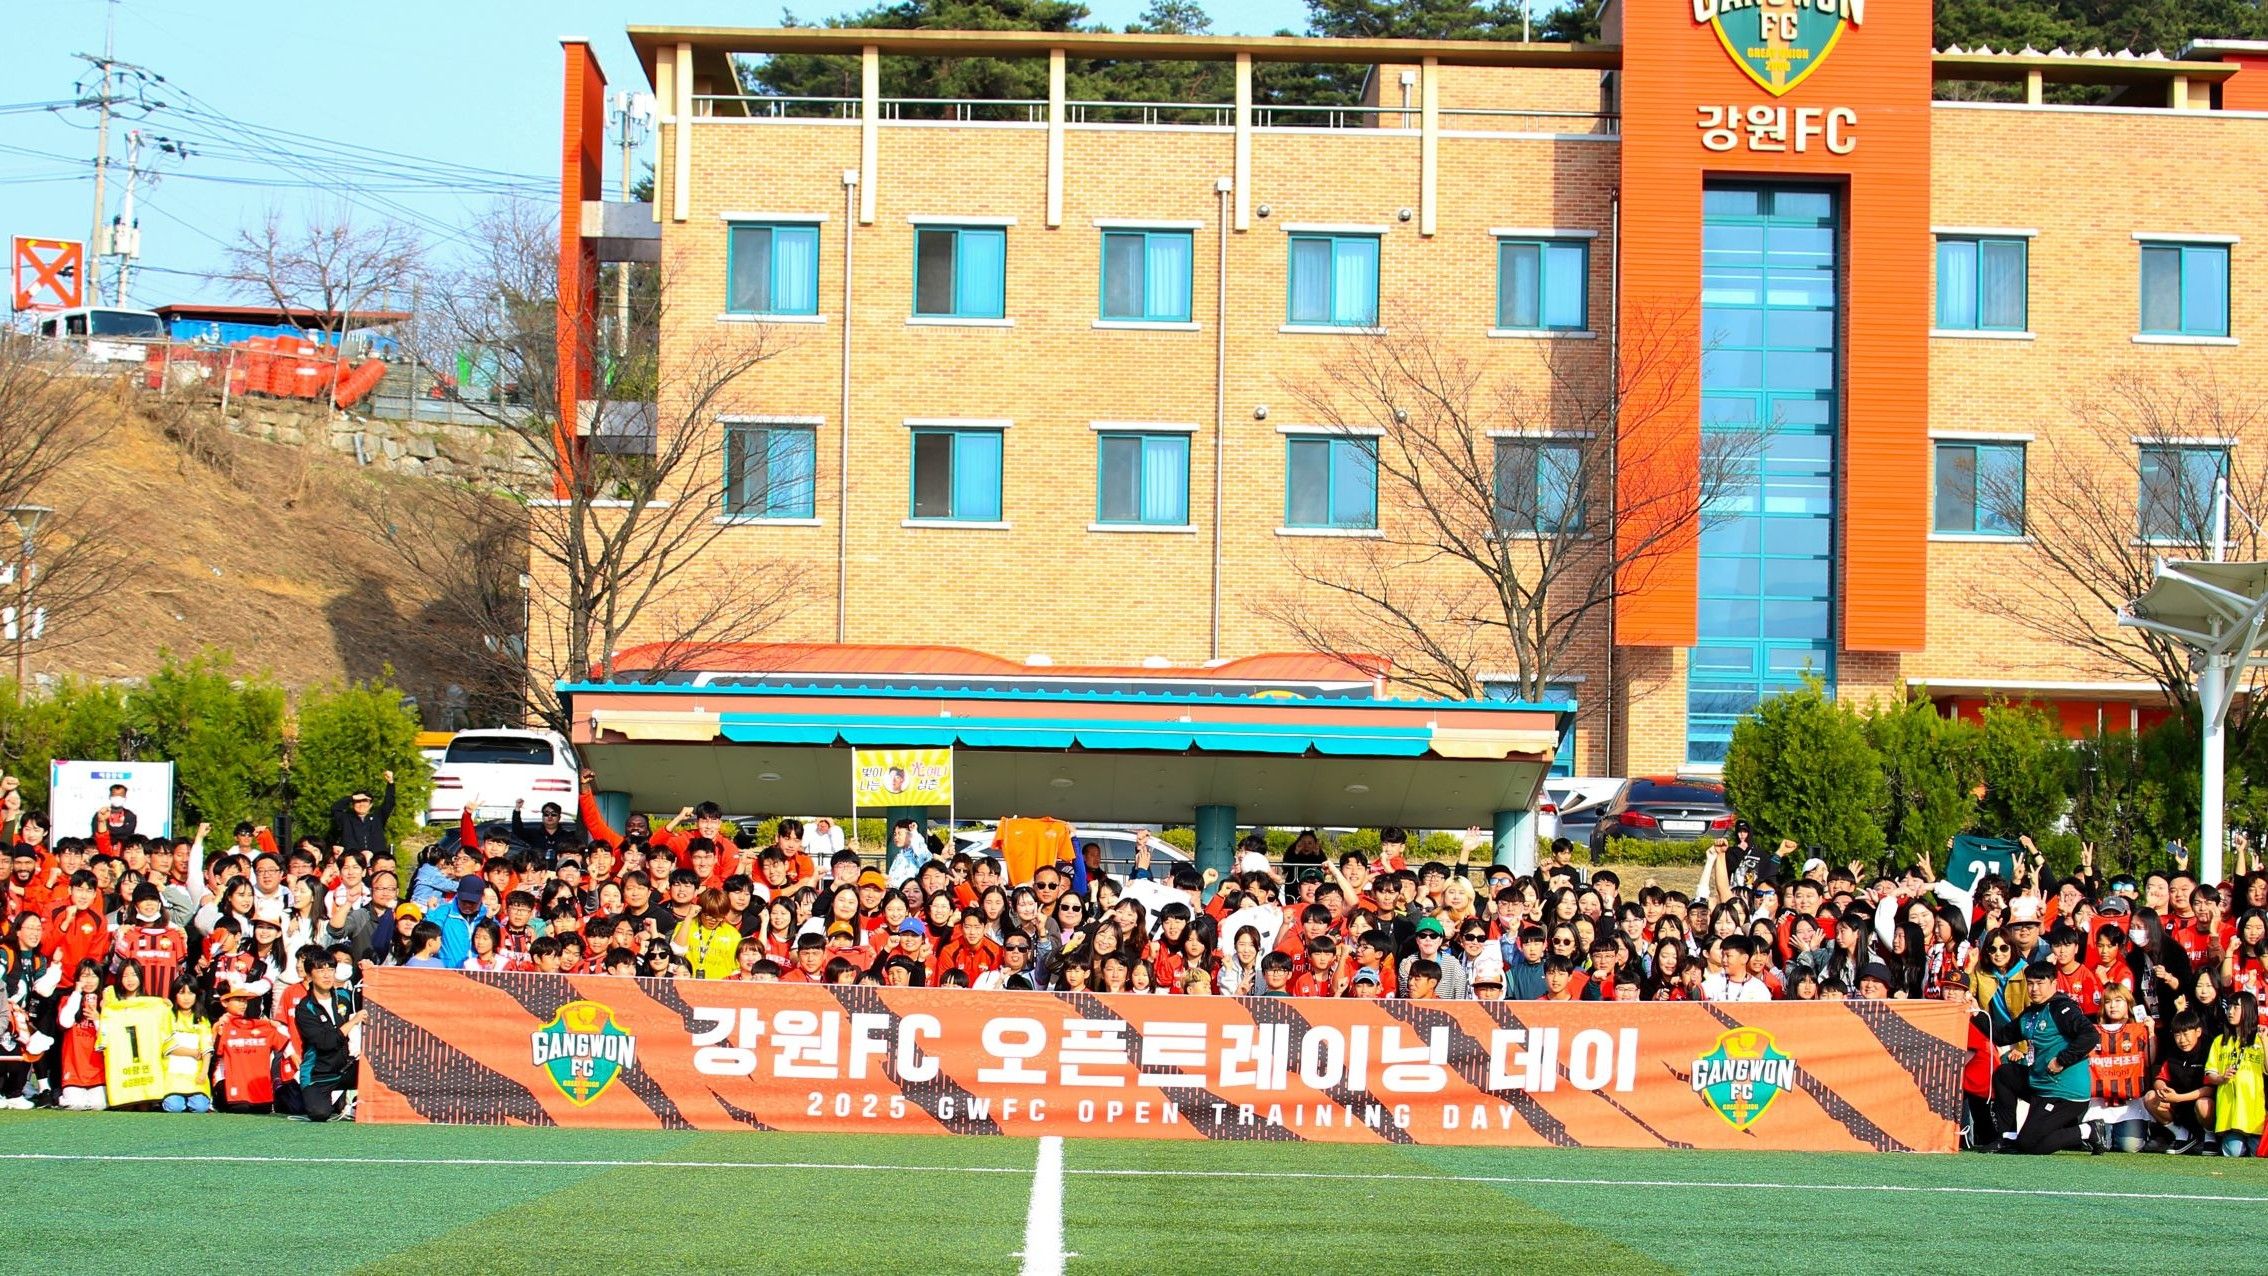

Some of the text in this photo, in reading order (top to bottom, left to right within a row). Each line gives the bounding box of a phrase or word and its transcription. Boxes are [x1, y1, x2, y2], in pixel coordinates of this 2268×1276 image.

[1760, 12, 1798, 41] FC
[1697, 104, 1857, 154] 강원FC
[125, 1025, 140, 1063] 1
[531, 1031, 636, 1067] GANGWON
[692, 1007, 1639, 1093] 강원FC 오픈트레이닝 데이
[570, 1059, 594, 1077] FC
[1691, 1059, 1796, 1092] GANGWON
[1730, 1083, 1753, 1100] FC
[806, 1091, 1515, 1130] 2025 GWFC OPEN TRAINING DAY
